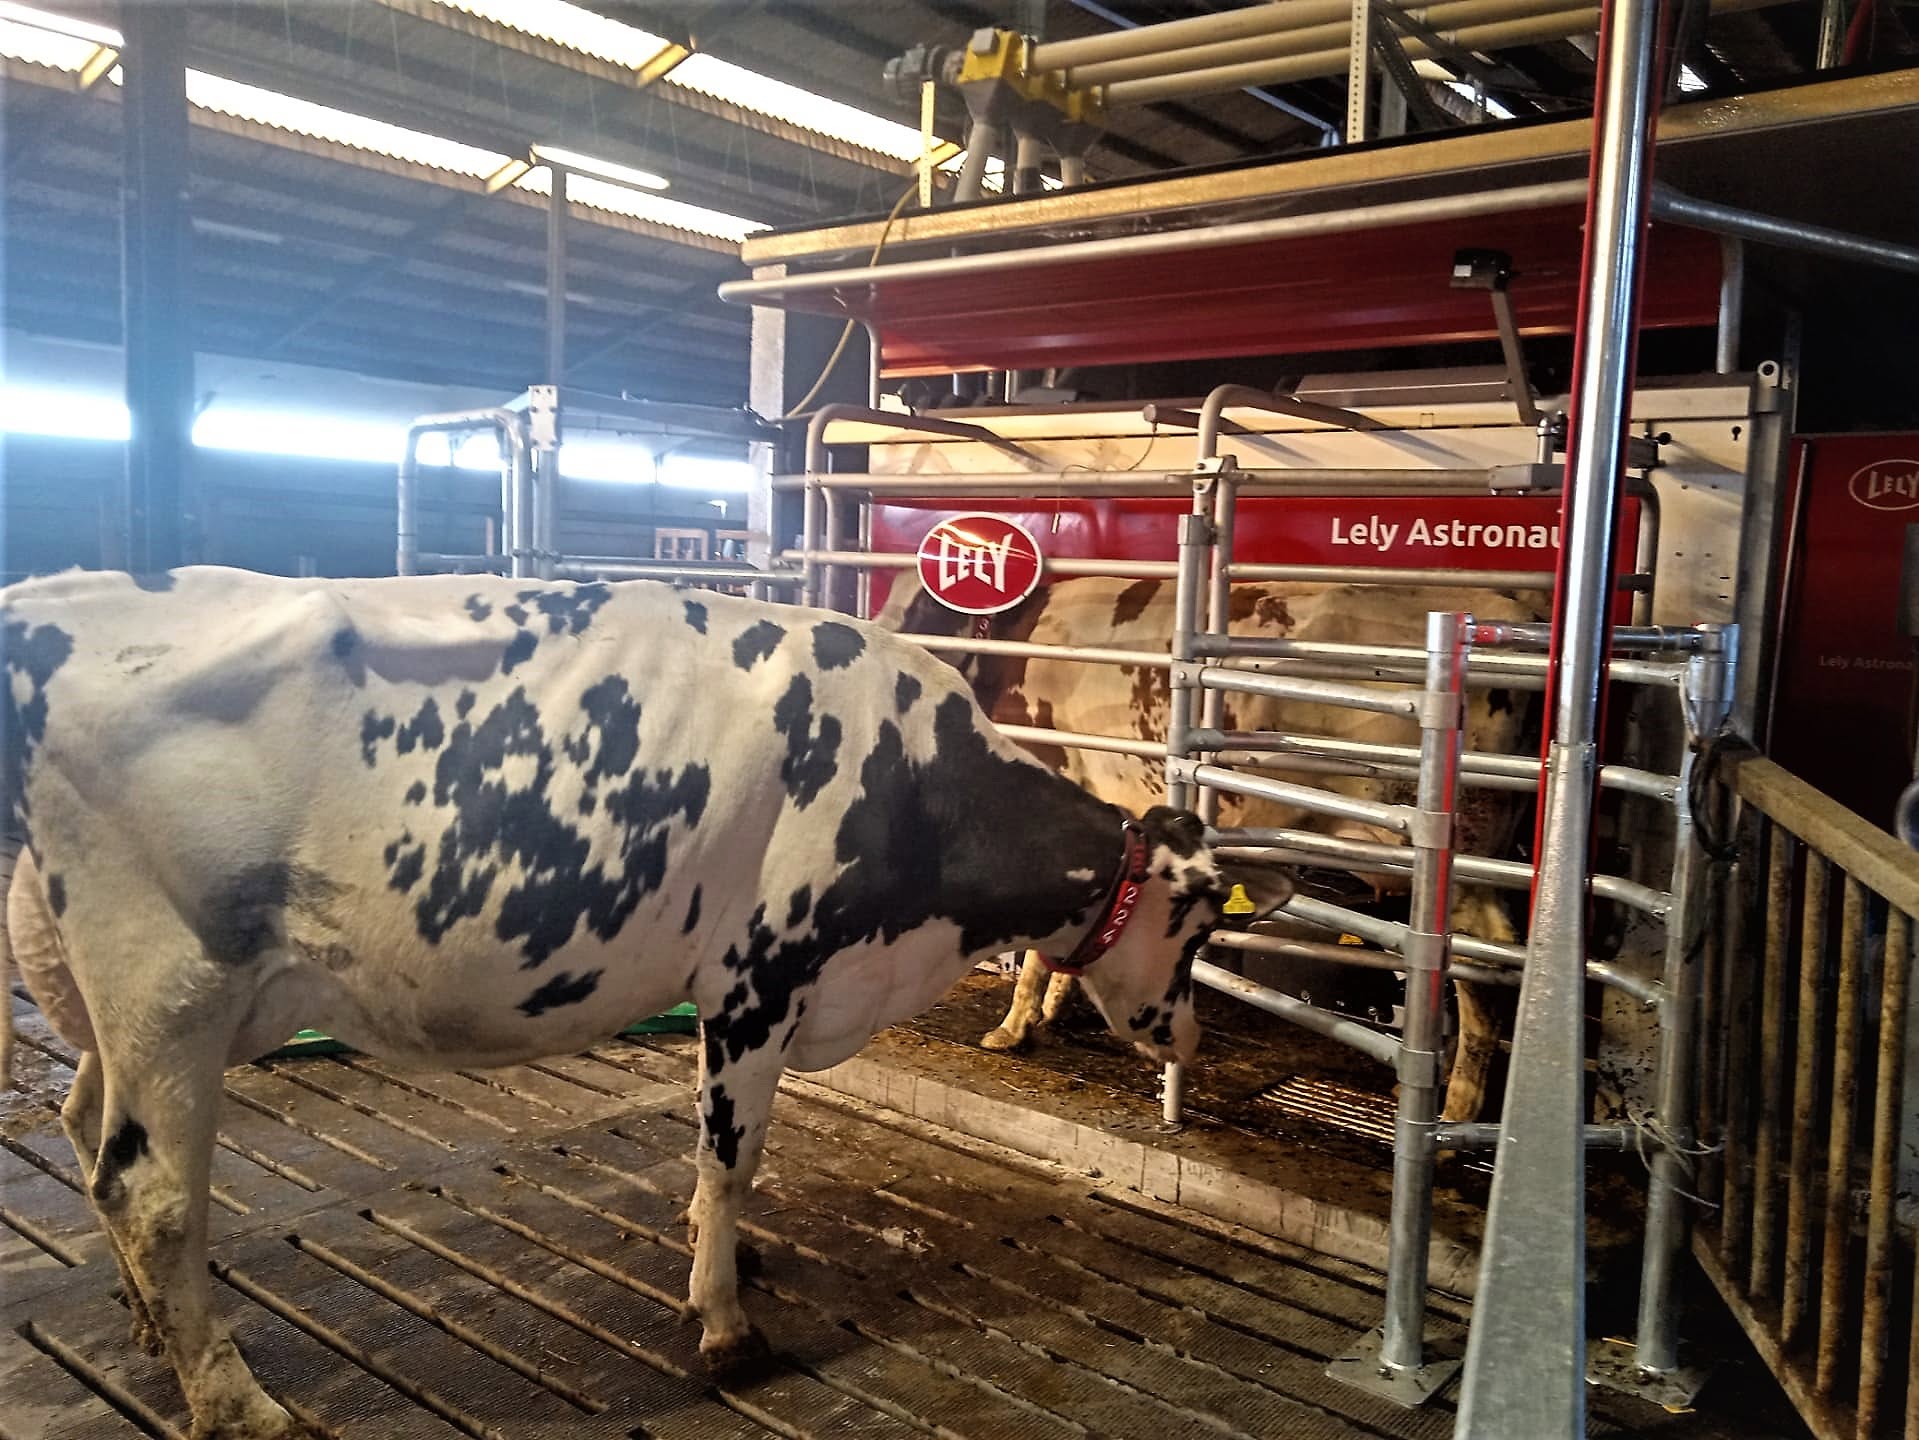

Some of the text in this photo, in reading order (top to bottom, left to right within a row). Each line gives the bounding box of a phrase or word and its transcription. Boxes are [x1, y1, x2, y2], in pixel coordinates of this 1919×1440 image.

[1867, 471, 1919, 499] LELY
[1331, 515, 1399, 552] Lely
[939, 532, 1014, 593] LELY
[1818, 655, 1849, 670] Lely
